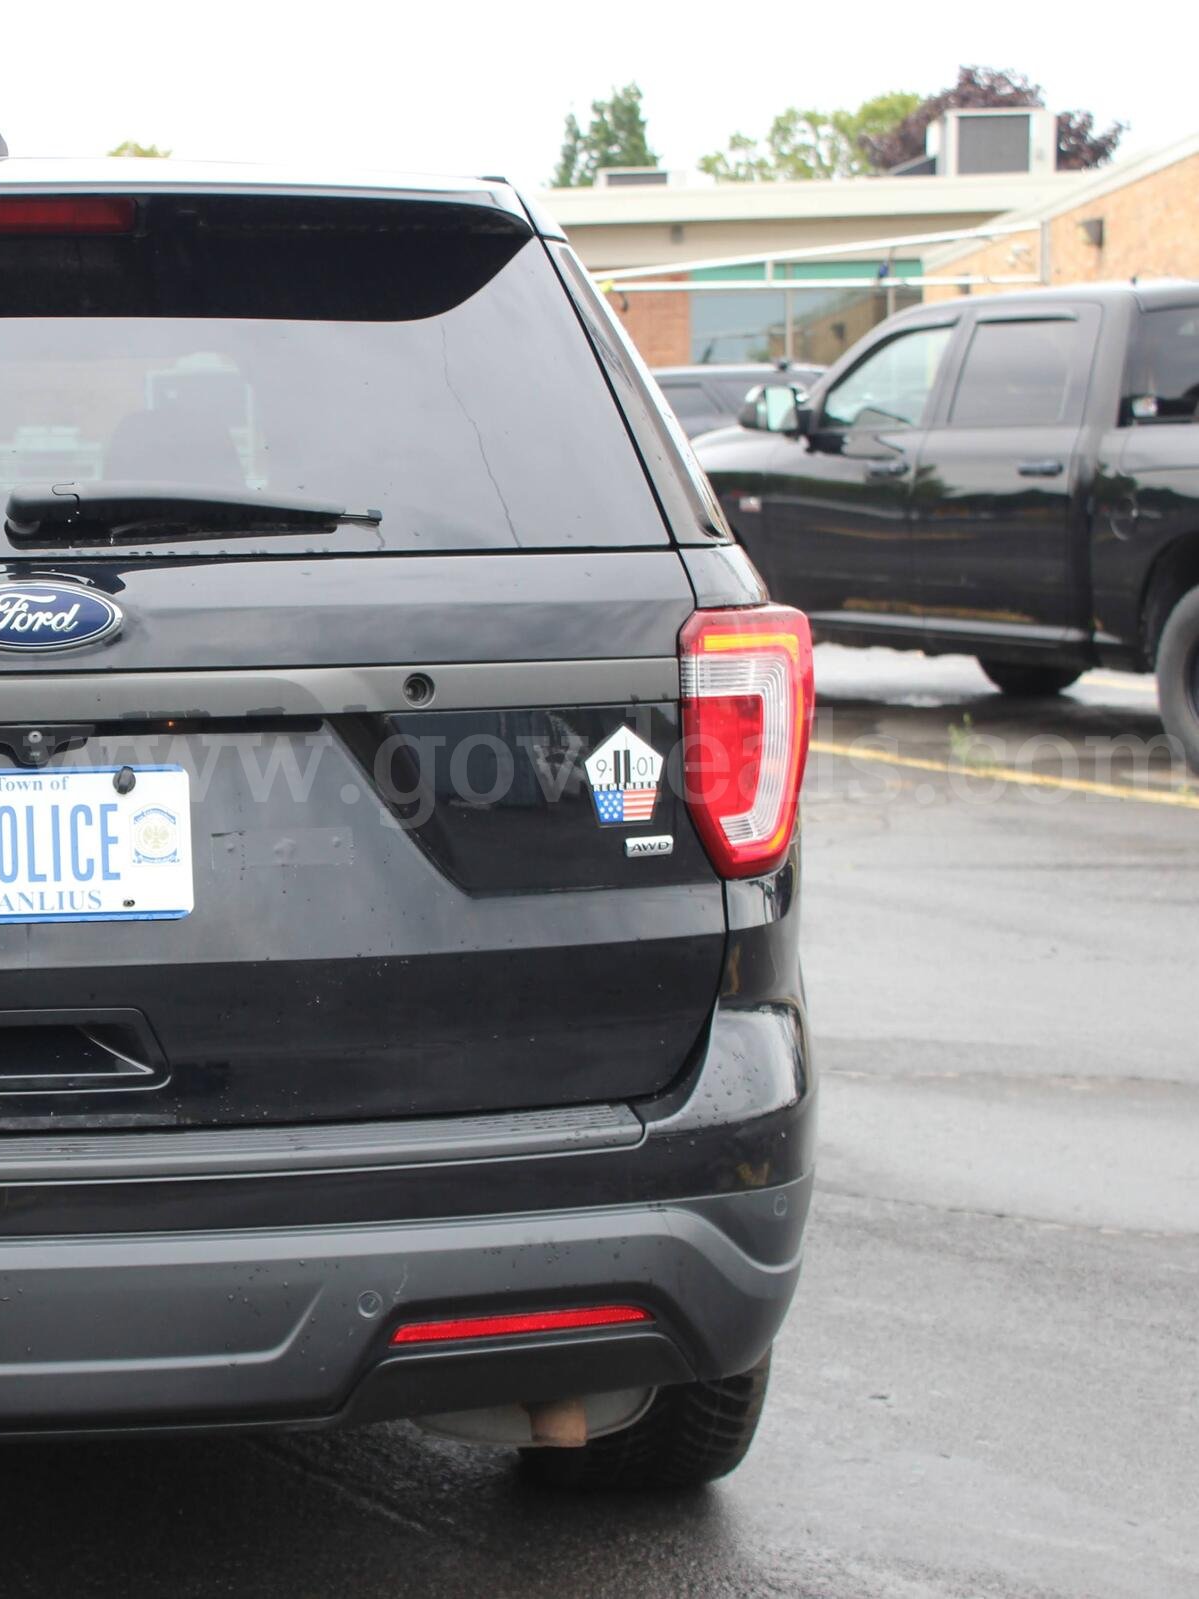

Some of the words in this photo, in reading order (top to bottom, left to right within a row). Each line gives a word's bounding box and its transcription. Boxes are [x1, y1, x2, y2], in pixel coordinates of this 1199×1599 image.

[50, 776, 70, 791] of
[593, 781, 657, 792] REMEMBER
[631, 841, 670, 852] AWD
